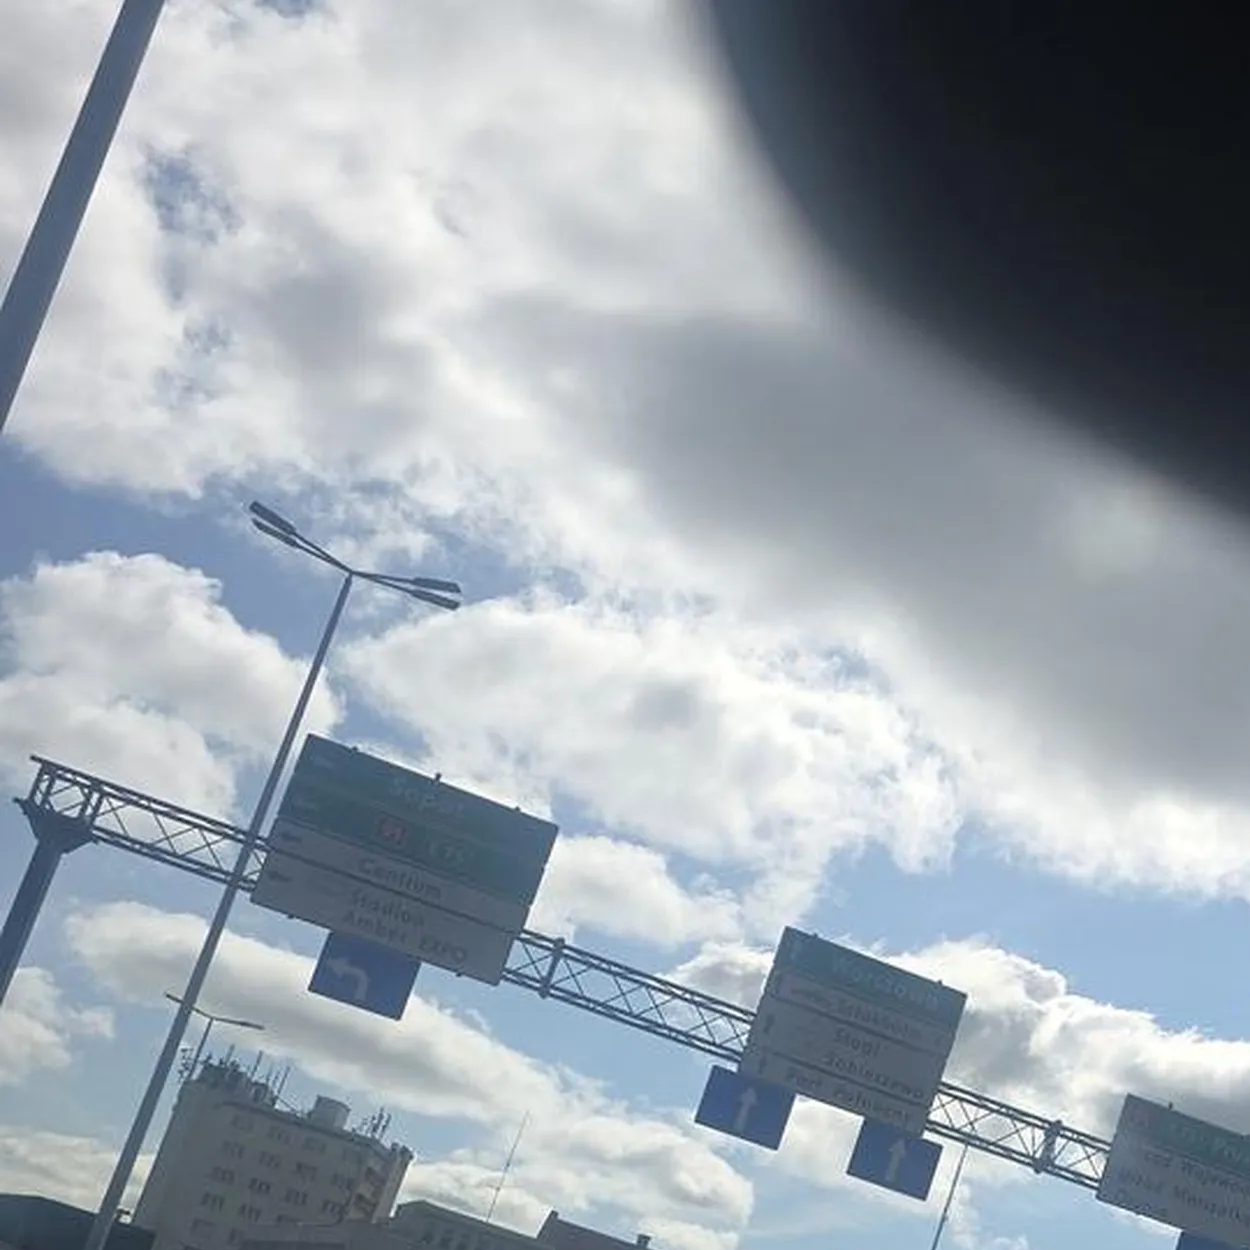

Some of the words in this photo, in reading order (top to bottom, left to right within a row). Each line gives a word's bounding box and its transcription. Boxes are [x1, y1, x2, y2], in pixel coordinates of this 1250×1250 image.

[355, 858, 444, 900] Centrum
[348, 887, 428, 927] Stadion
[340, 907, 409, 944] Amber
[417, 934, 468, 963] EXPO
